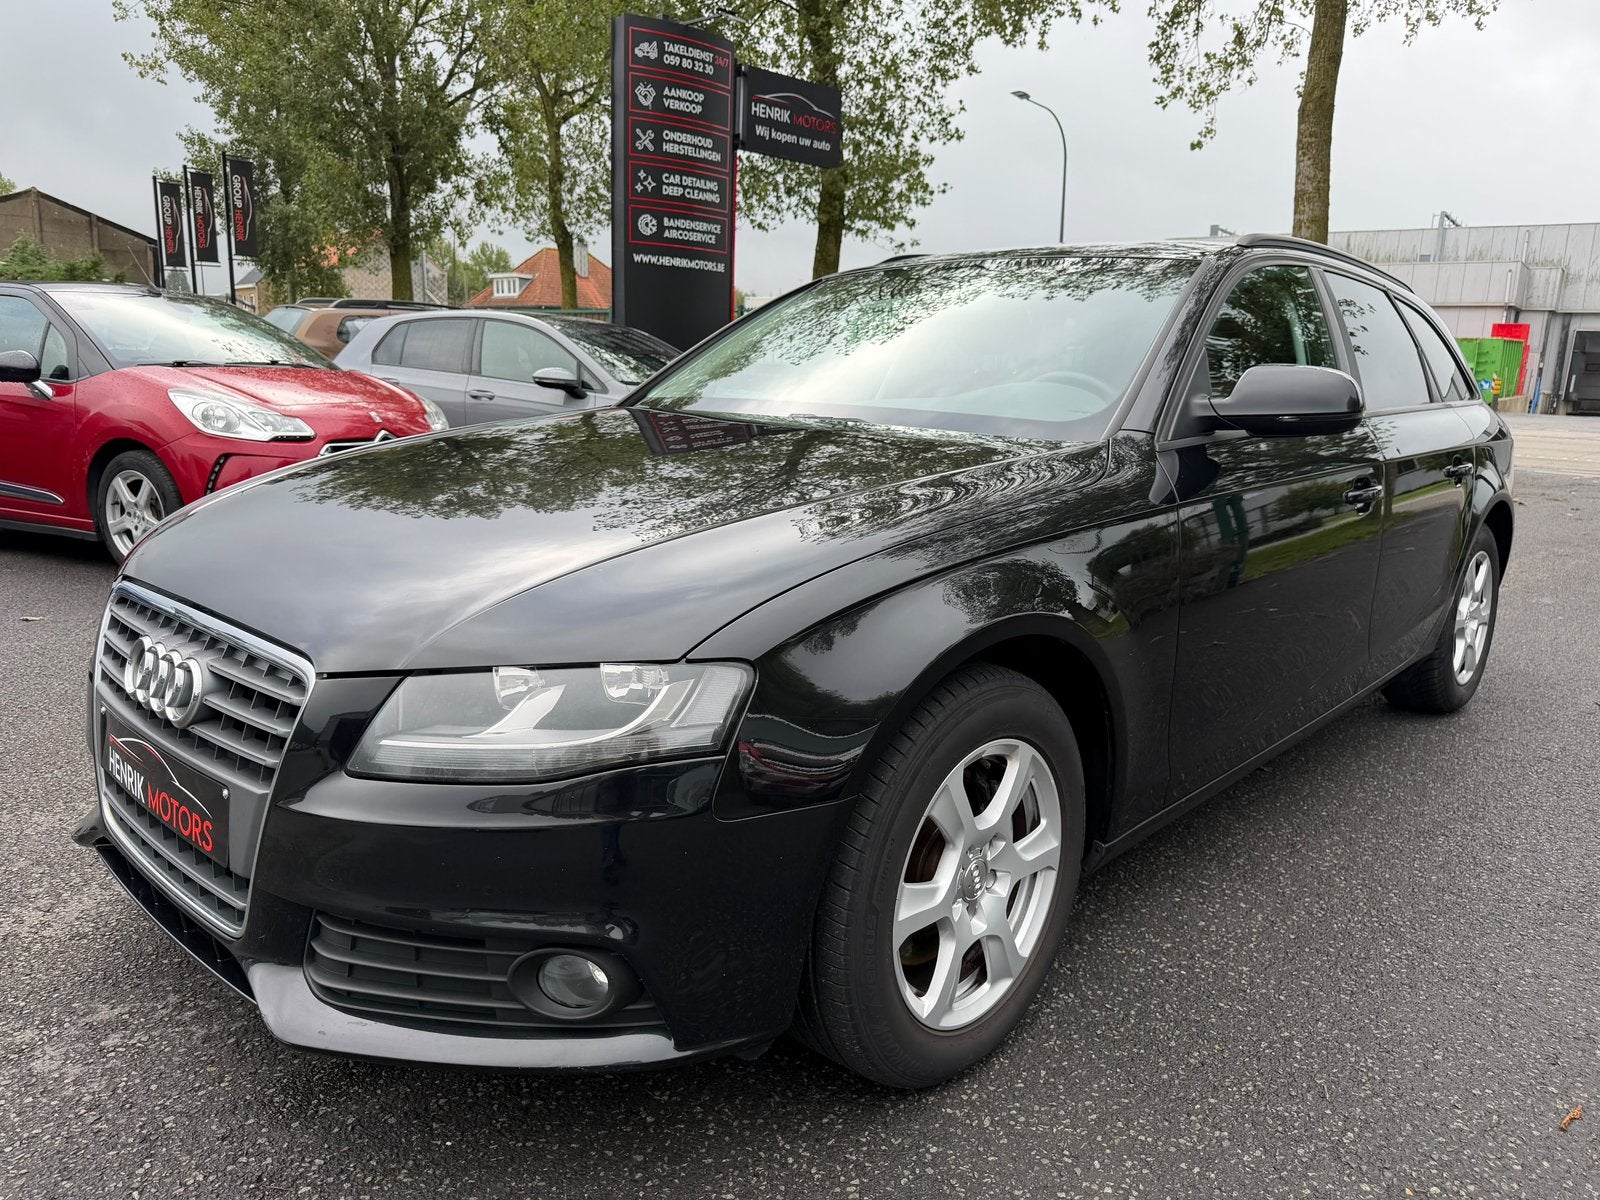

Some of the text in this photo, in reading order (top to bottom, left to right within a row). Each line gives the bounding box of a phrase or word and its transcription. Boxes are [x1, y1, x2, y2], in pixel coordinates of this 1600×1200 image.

[663, 41, 729, 68] TAKELDIENST 24/7
[663, 54, 714, 75] 059 80 32 30
[663, 86, 705, 103] AANKOOP
[663, 97, 702, 115] VERKOOP
[751, 101, 837, 135] HENRIK MOTORS
[662, 130, 713, 148] ONDERHOUD
[755, 124, 831, 151] Wij kopen uw auto
[662, 142, 721, 162] HERSTELLINGEN
[662, 173, 719, 191] CAR DETAILING
[662, 184, 720, 203] DEEP CLEANING
[194, 186, 206, 249] HENRIK MOTORS
[232, 174, 245, 241] GROUP HENRIK
[162, 195, 175, 254] GROUP HENRIK
[663, 217, 721, 234] BANDENSERVICE
[663, 229, 716, 244] AIRCOSERVICE
[633, 253, 725, 272] WWW.HENRIKMOTORS.BE
[108, 746, 214, 852] HENRIK MOTORS
